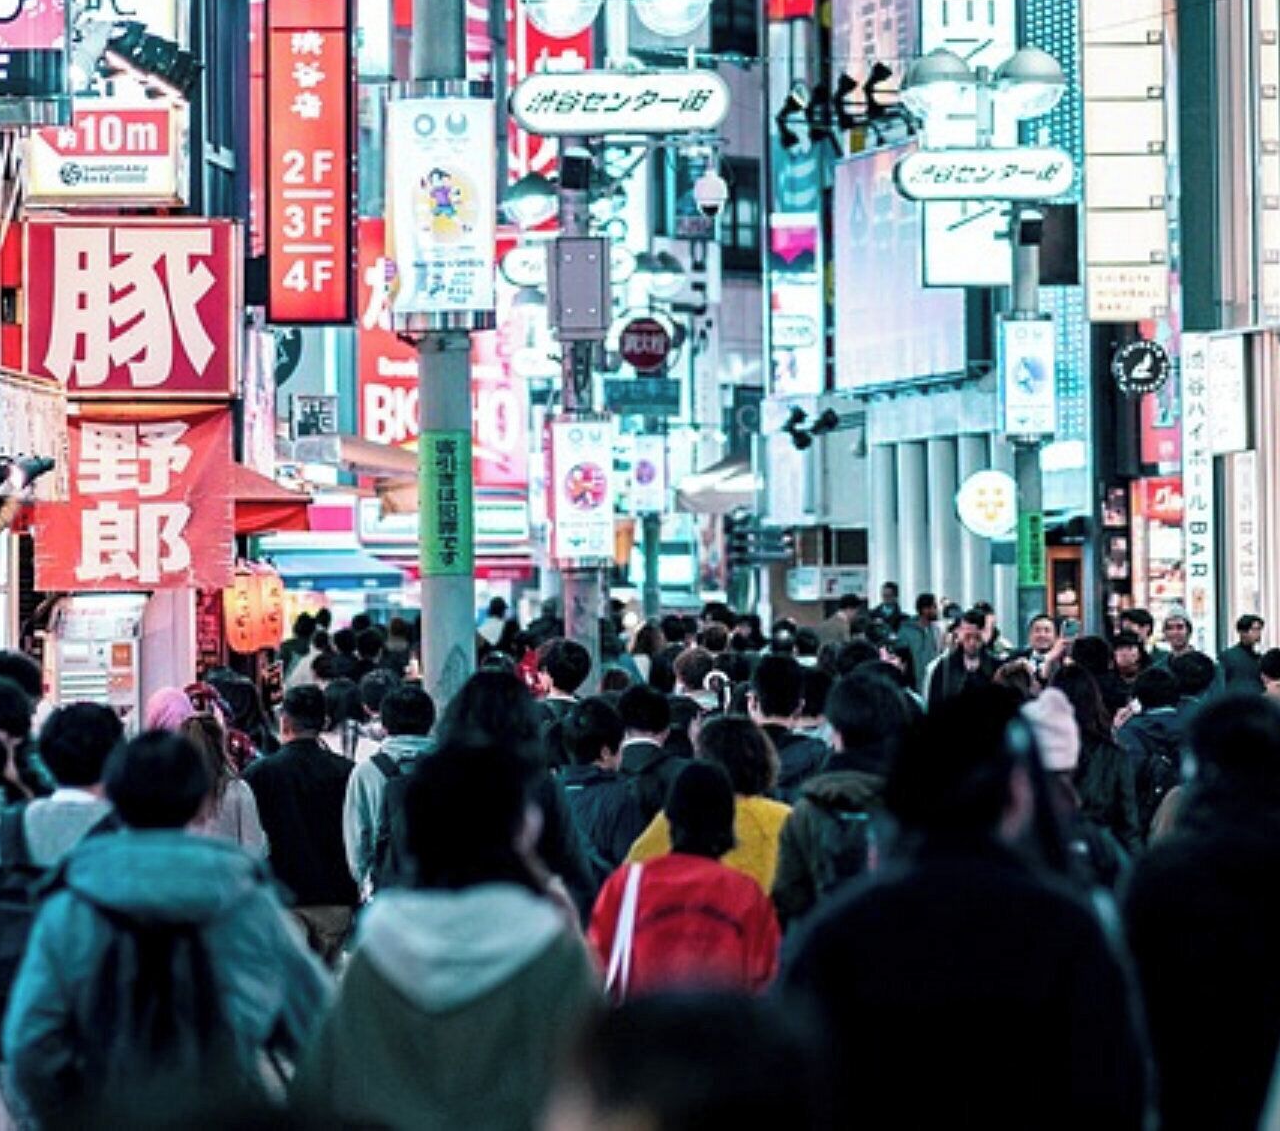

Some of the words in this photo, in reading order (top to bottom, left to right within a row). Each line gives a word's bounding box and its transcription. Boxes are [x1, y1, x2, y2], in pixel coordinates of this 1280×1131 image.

[524, 88, 714, 114] 渋谷センター街
[282, 151, 333, 184] 2F
[282, 204, 333, 238] 3F
[282, 260, 333, 293] 4F
[44, 227, 216, 387] 豚
[75, 422, 194, 583] 野郎
